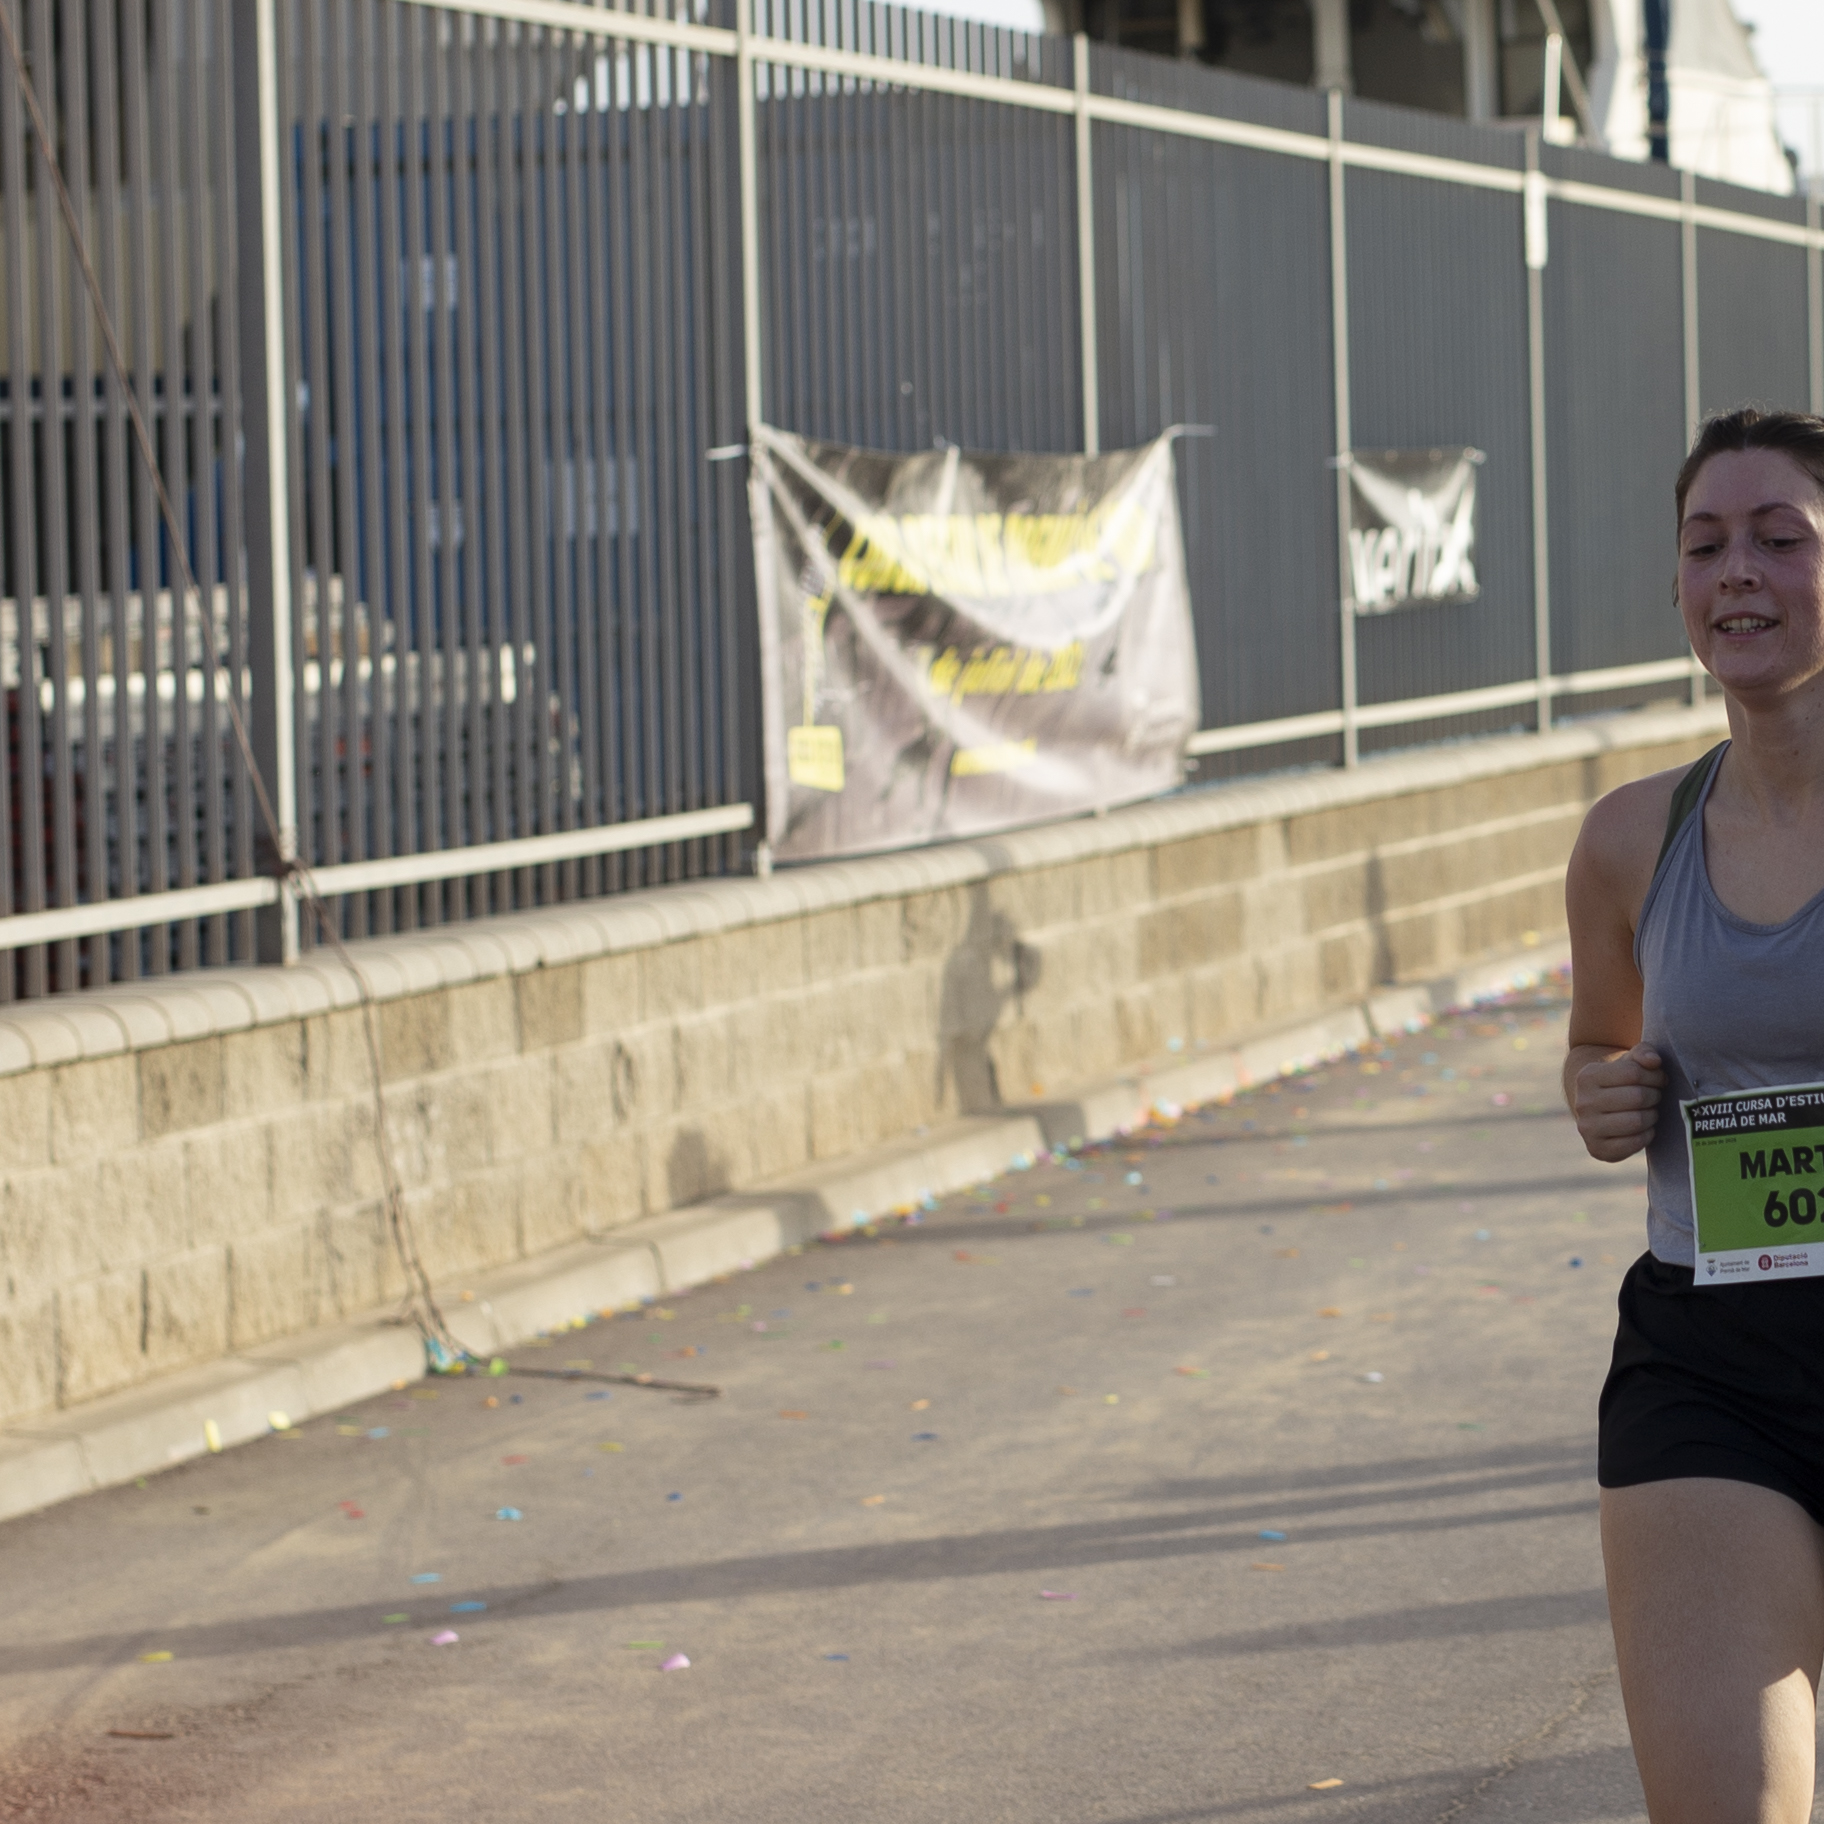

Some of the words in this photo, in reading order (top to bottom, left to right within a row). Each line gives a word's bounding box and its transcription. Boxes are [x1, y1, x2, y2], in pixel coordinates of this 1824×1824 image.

[1692, 1102, 1733, 1117] XXVIII
[1735, 1097, 1773, 1112] CURSA
[1695, 1114, 1737, 1132] PREMIÀ
[1740, 1115, 1755, 1127] DE
[1758, 1111, 1787, 1125] MAR
